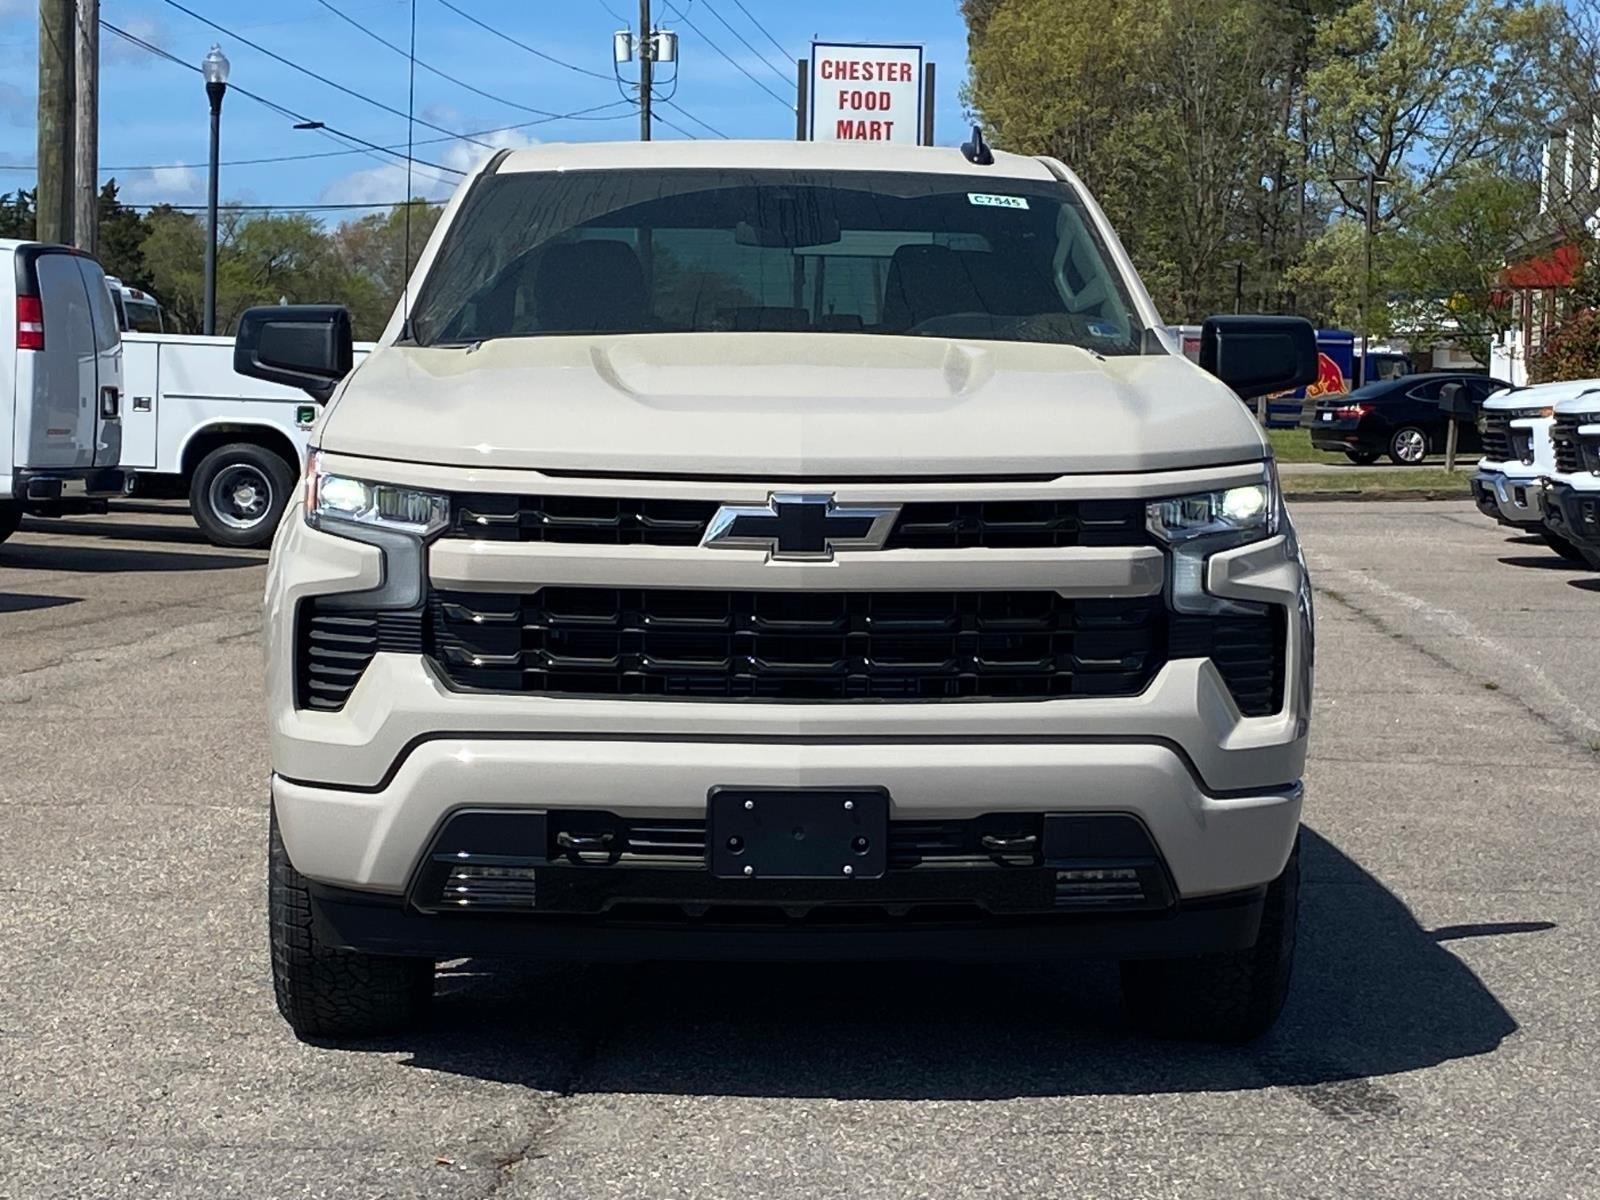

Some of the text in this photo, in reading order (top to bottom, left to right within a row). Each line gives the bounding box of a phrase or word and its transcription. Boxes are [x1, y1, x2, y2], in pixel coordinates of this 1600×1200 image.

[821, 60, 912, 82] CHESTER
[839, 90, 891, 111] FOOD
[836, 119, 894, 141] MART
